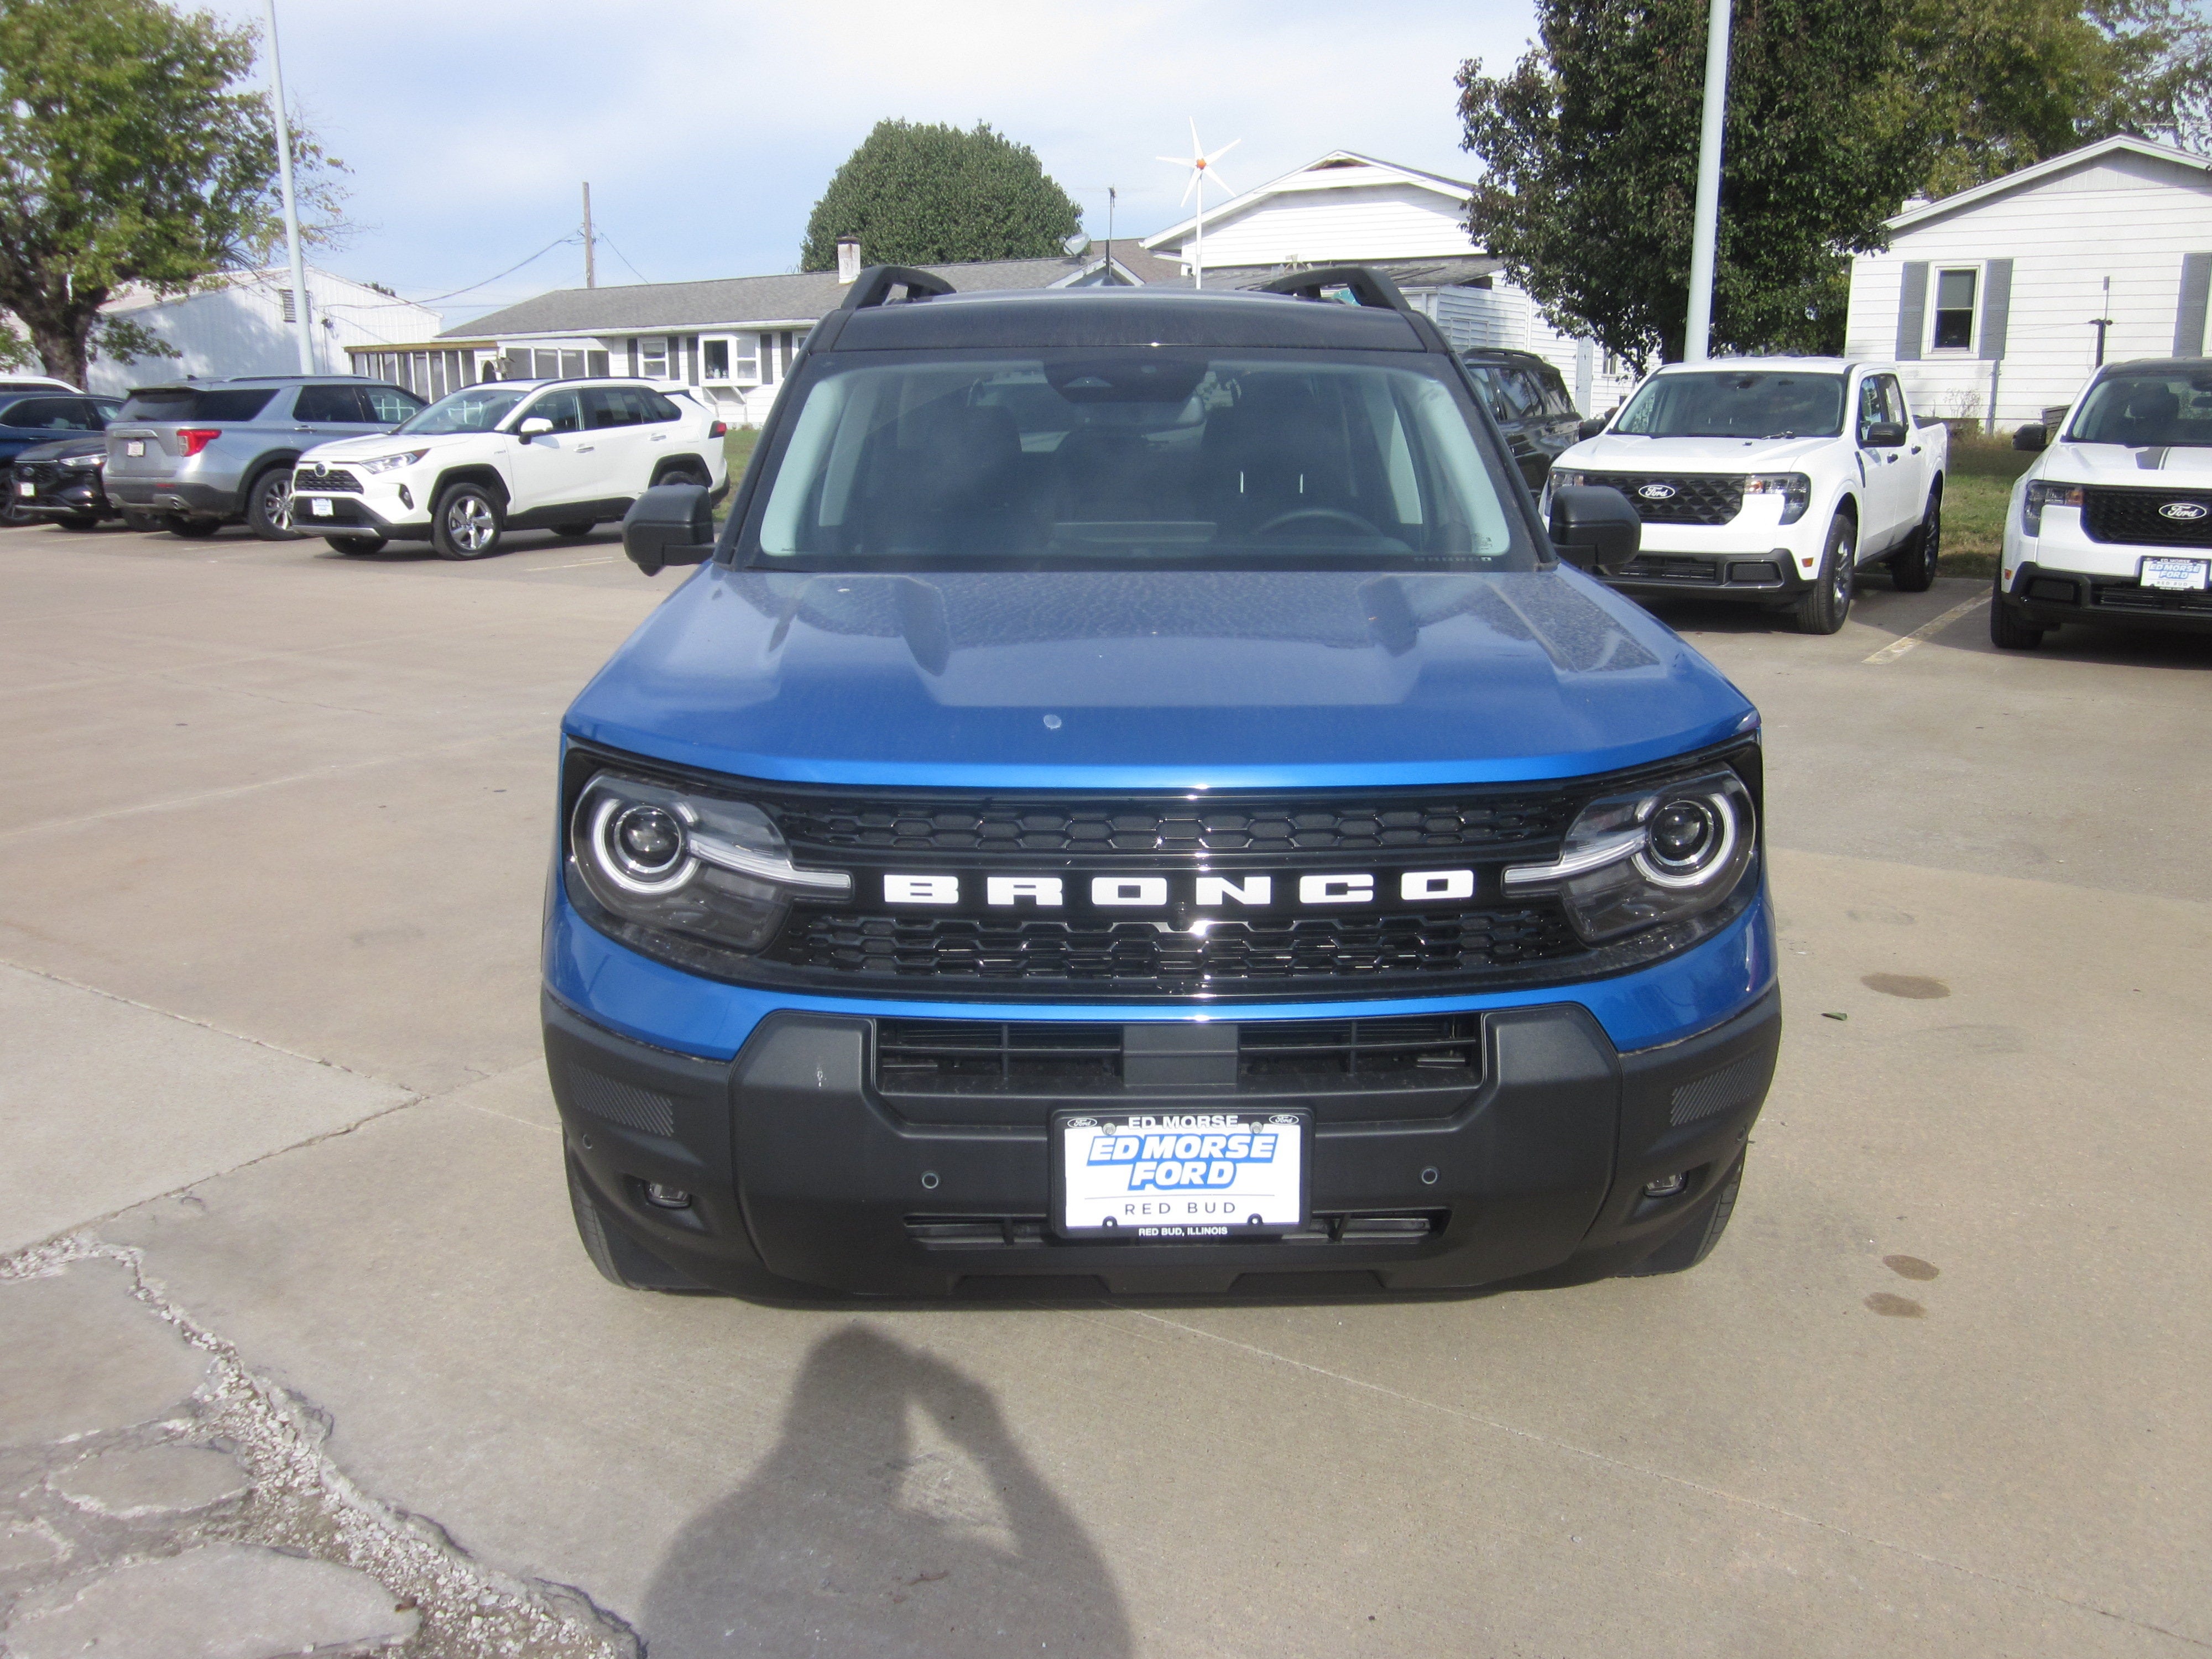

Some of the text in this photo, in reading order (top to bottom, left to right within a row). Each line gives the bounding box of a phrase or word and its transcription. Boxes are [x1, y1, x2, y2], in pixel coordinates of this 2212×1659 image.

[1645, 486, 1668, 497] Ford
[2168, 505, 2198, 517] Ford
[2163, 564, 2201, 573] MORSE
[2159, 571, 2189, 580] FORD
[884, 869, 1474, 905] BRONCO
[1073, 1118, 1092, 1127] Ford
[1128, 1115, 1239, 1129] ED MORSE
[1275, 1115, 1293, 1124] Ford
[1087, 1134, 1277, 1162] ED MORSE
[1129, 1161, 1235, 1188] FORD
[1125, 1202, 1235, 1215] RED BUD
[1138, 1227, 1228, 1237] RED BUD, ILLINOIS
